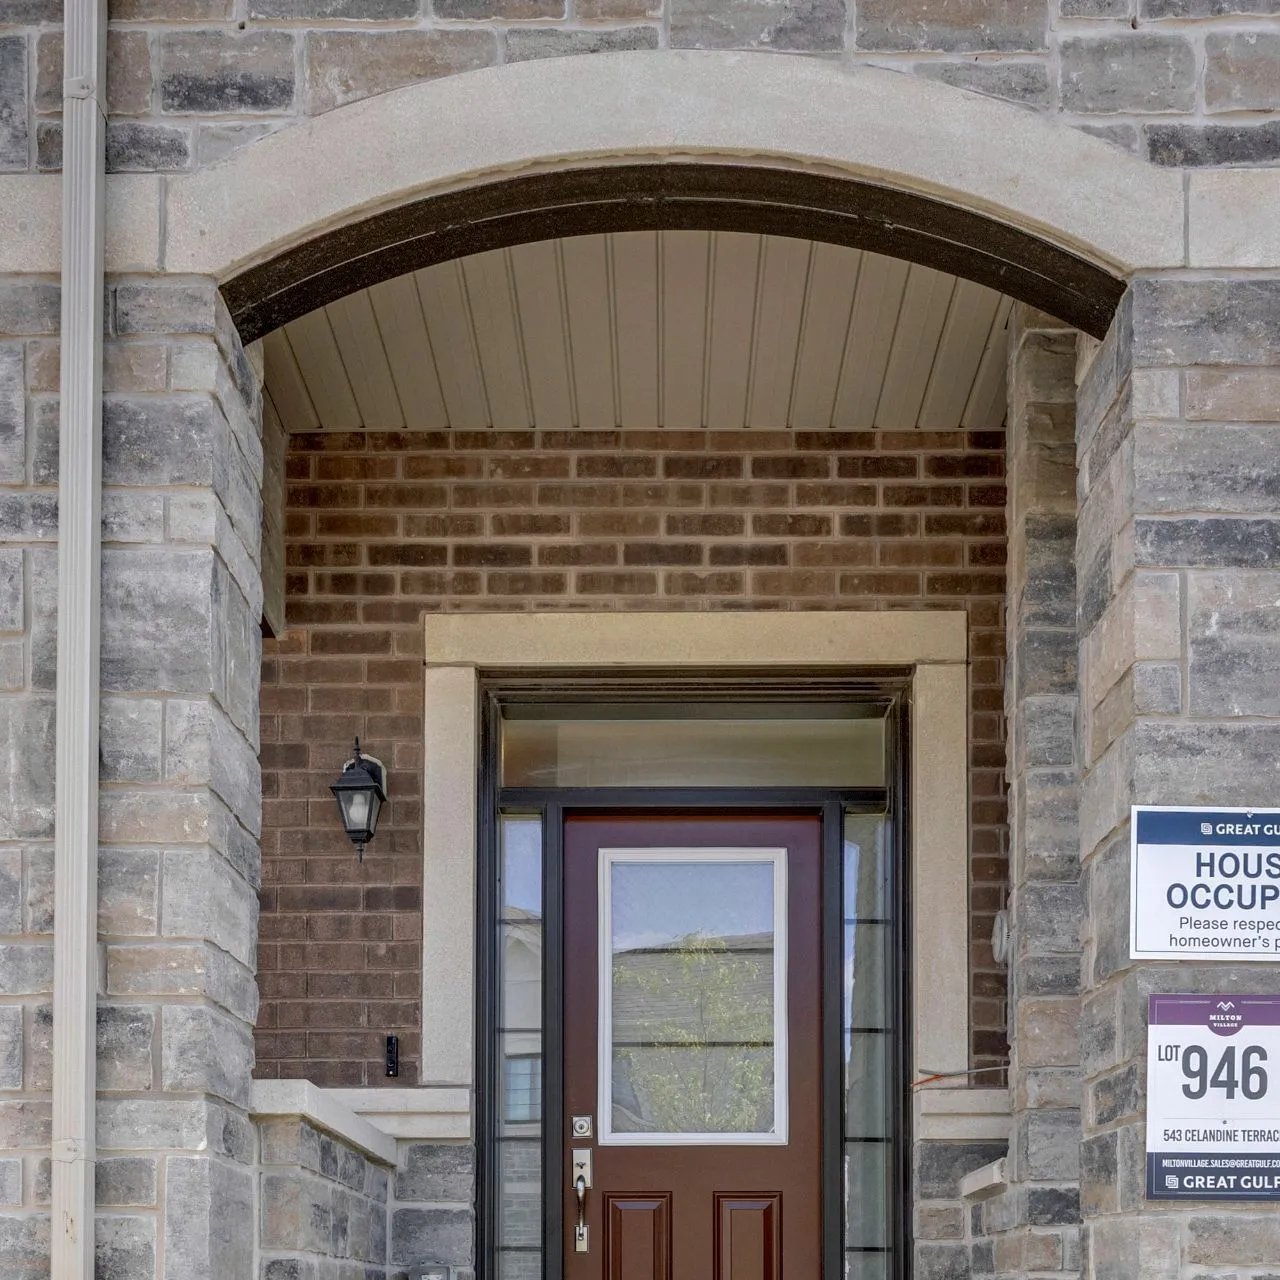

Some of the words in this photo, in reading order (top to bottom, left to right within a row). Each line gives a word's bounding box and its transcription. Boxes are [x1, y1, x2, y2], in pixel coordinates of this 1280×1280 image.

[1216, 823, 1261, 835] GREAT
[1179, 917, 1228, 930] Please
[1169, 934, 1270, 949] homeowner's
[1158, 1045, 1181, 1062] LOT
[1181, 1044, 1268, 1100] 946
[1163, 1129, 1183, 1142] 543
[1184, 1129, 1239, 1142] CELANDINE
[1183, 1175, 1237, 1189] GREAT
